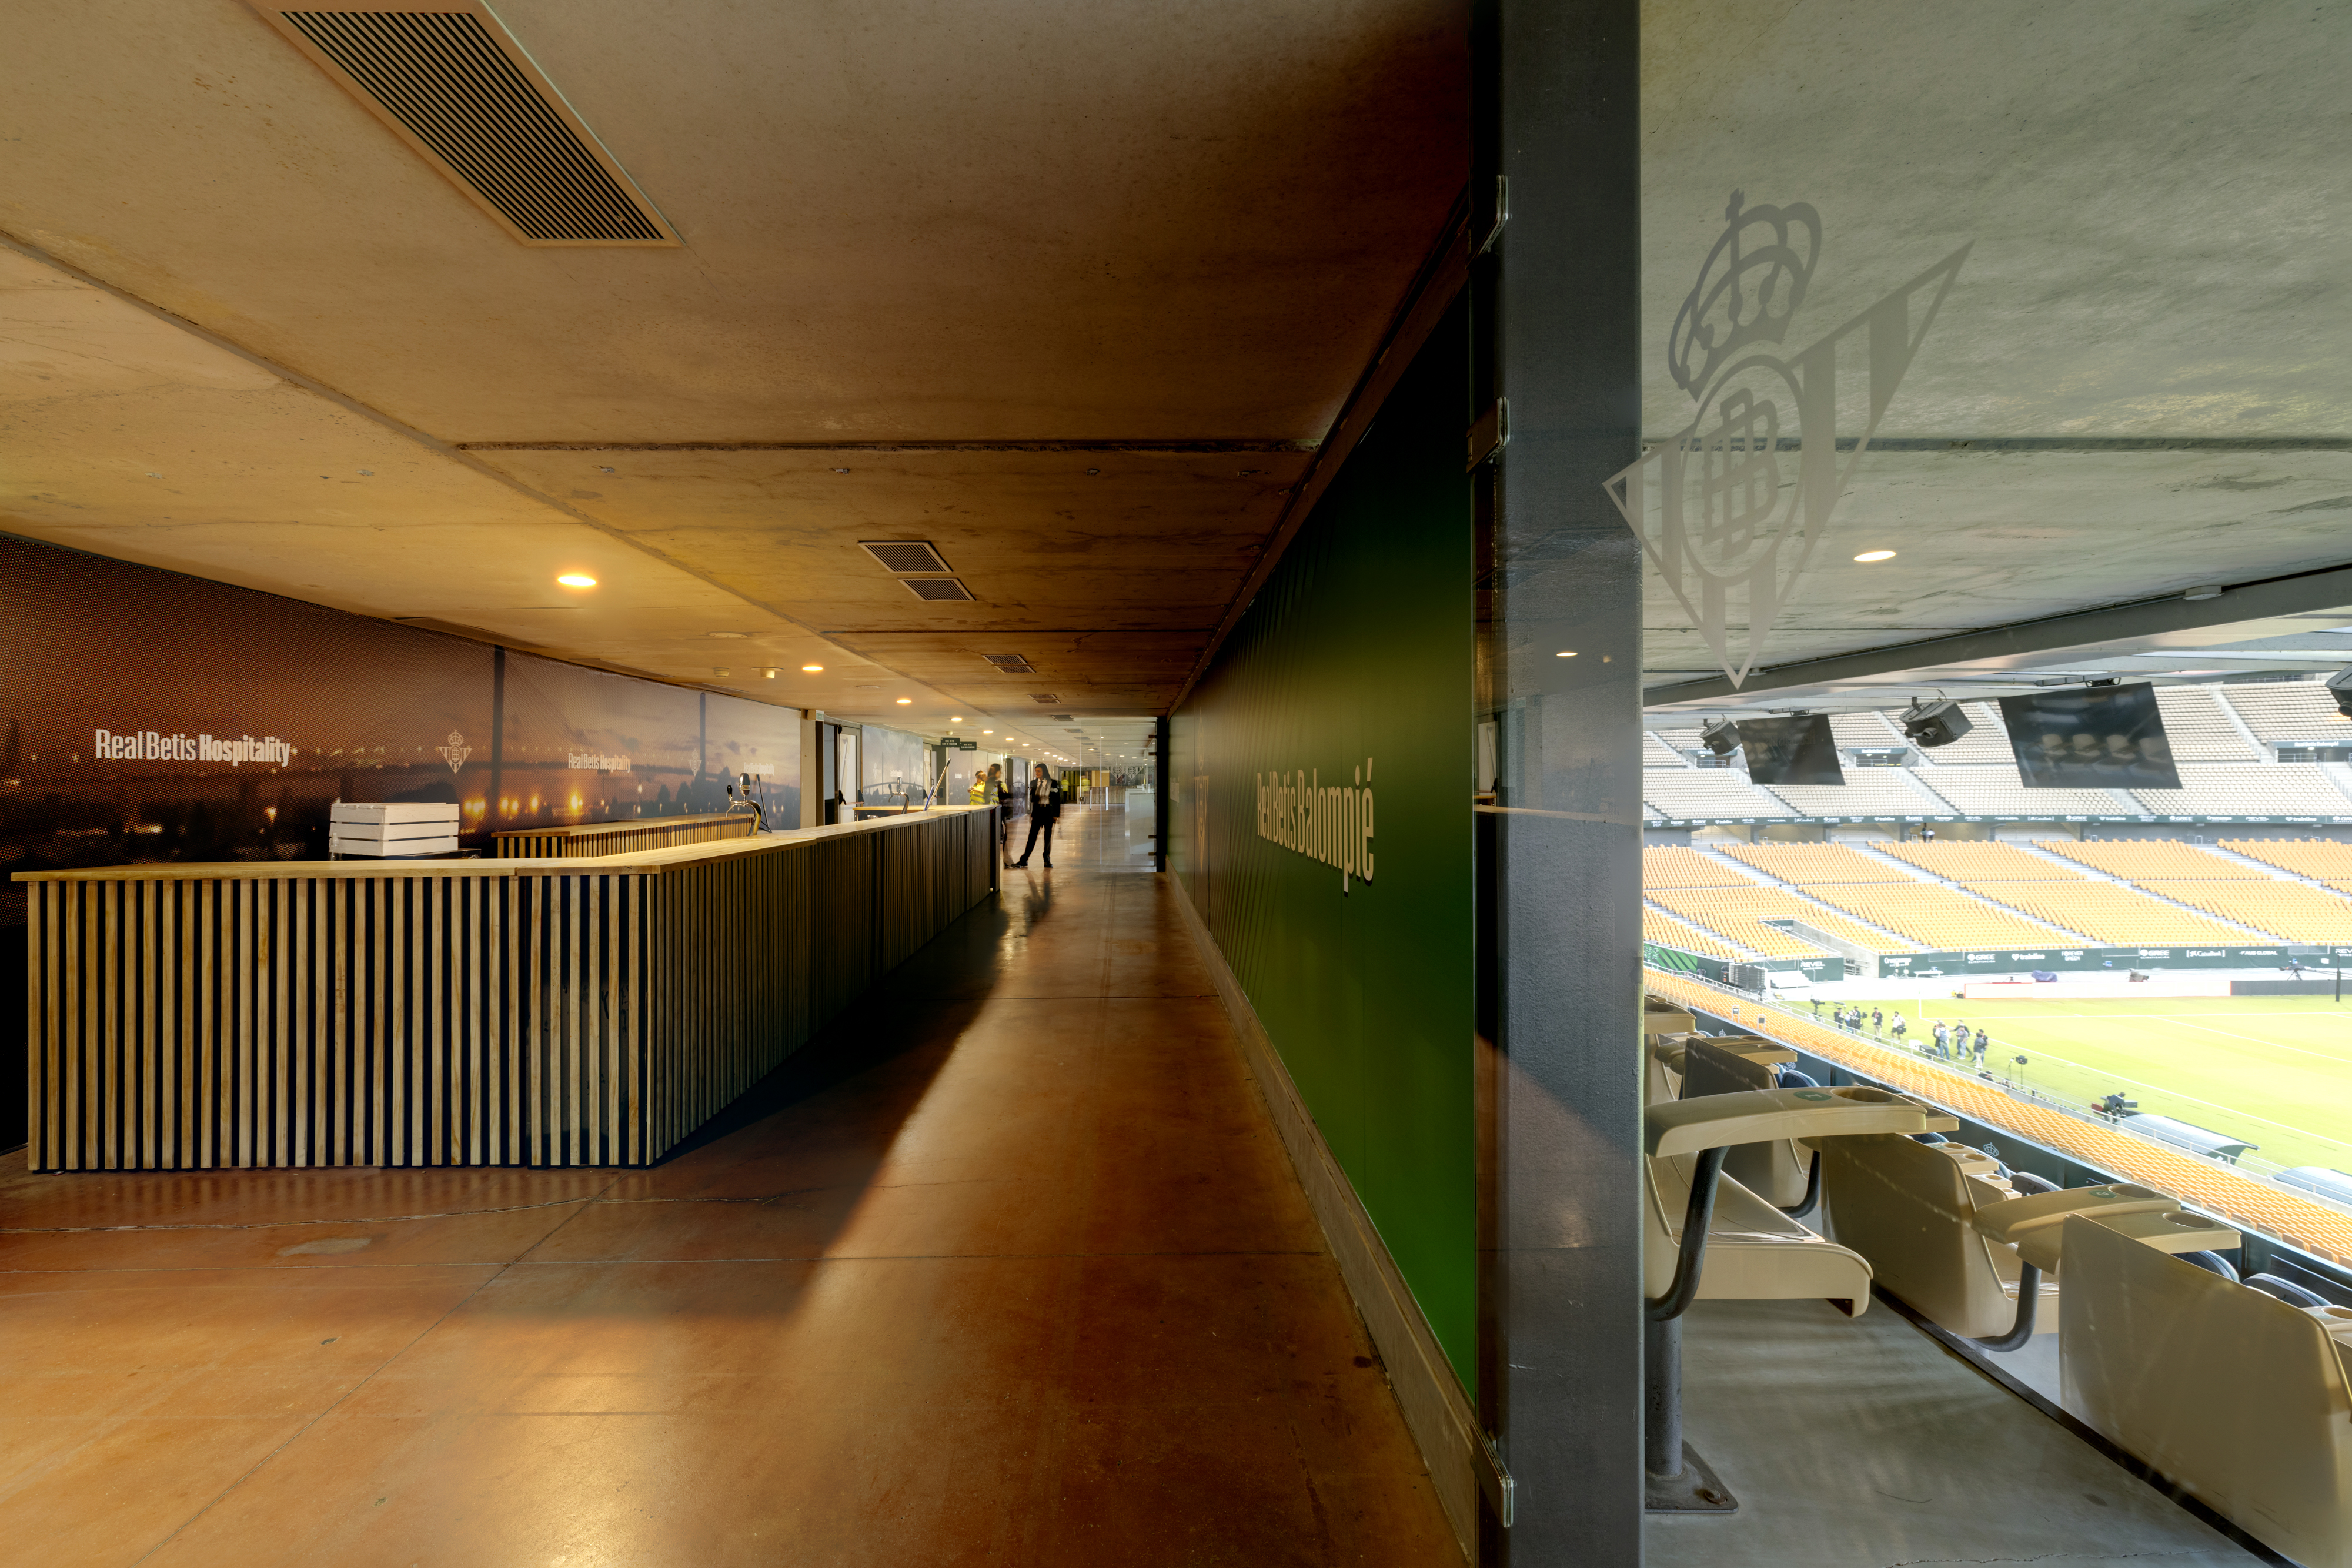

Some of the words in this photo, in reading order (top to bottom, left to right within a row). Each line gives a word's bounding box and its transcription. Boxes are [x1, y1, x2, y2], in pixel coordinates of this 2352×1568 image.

[96, 729, 143, 759] Real
[146, 731, 196, 760] Betis
[199, 734, 290, 767] Hospitality
[569, 753, 583, 769] Real
[583, 753, 599, 770] Betis
[600, 754, 631, 773] Hospitality
[1257, 771, 1272, 841] Real
[1272, 771, 1296, 851] Betis
[1298, 757, 1374, 893] Balompié
